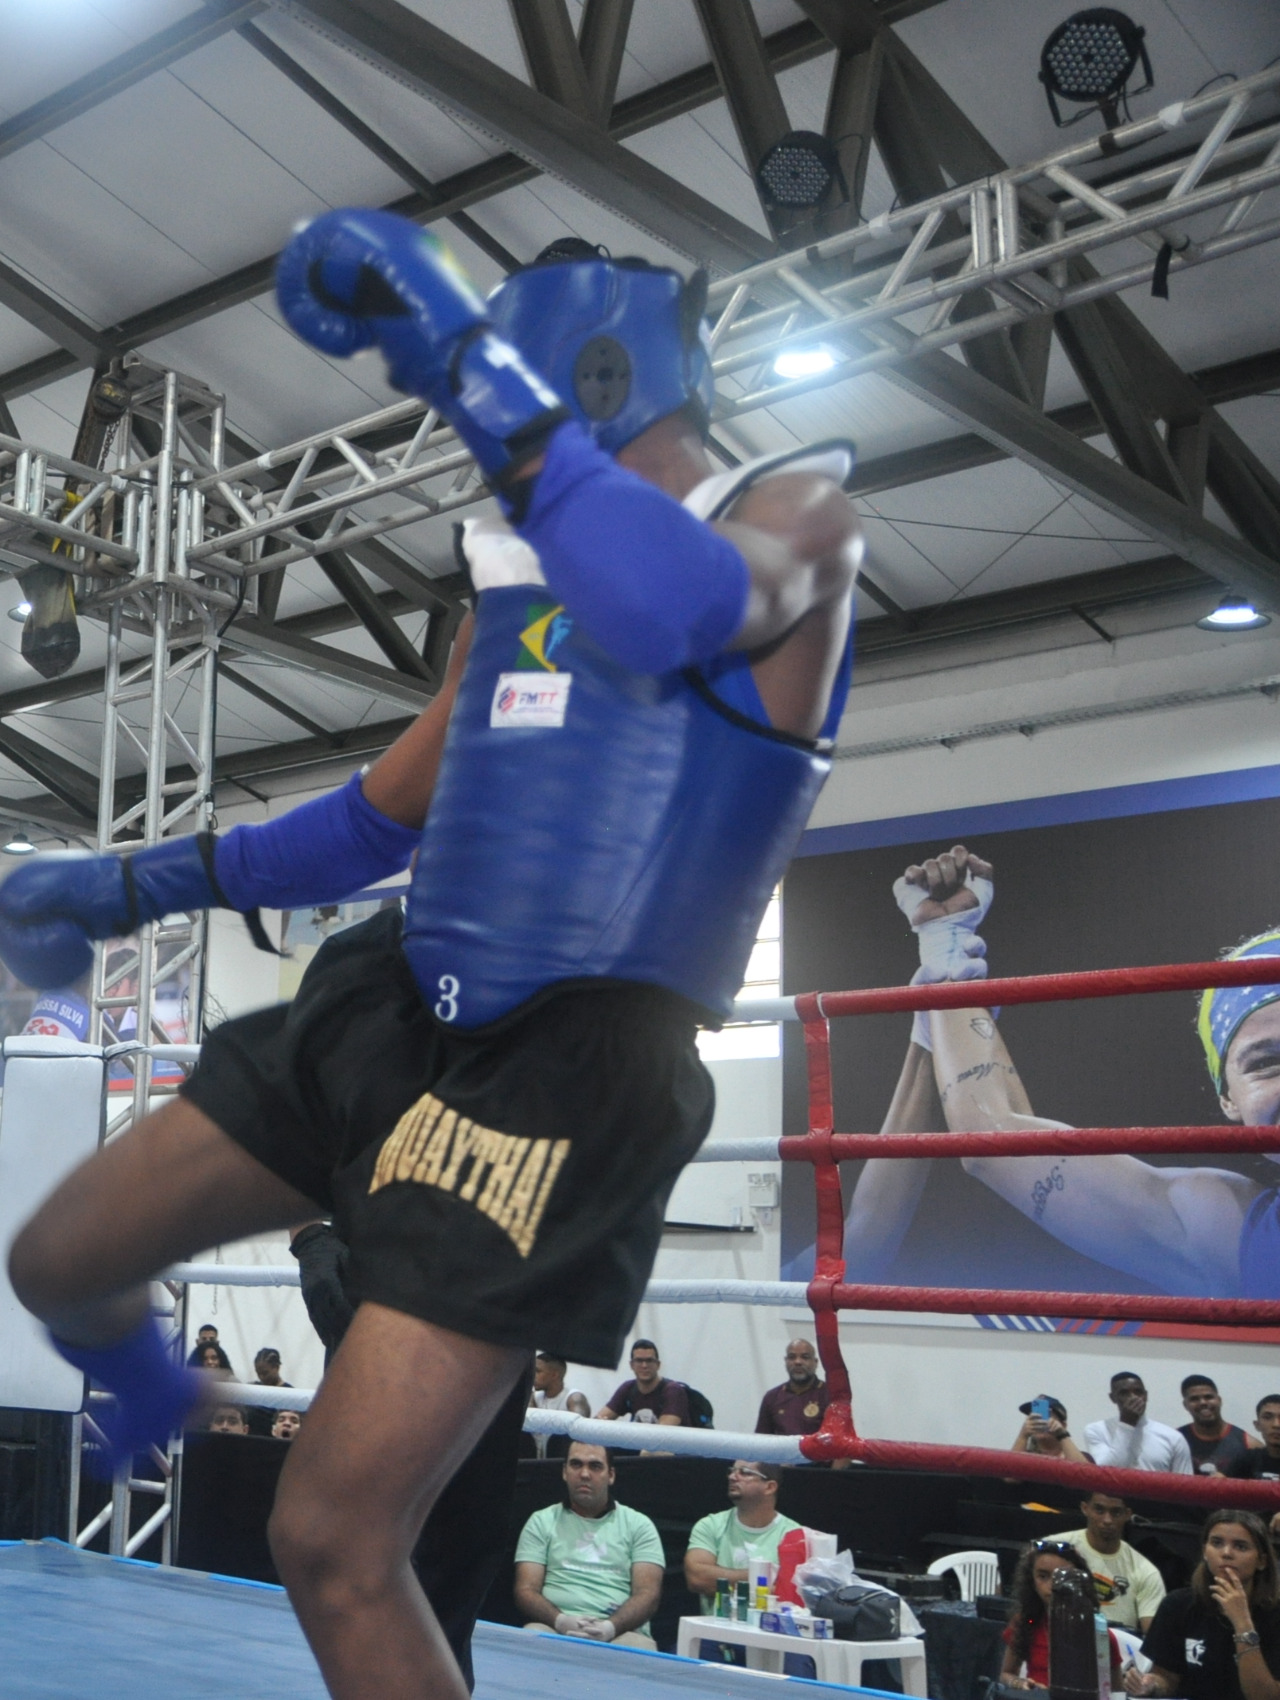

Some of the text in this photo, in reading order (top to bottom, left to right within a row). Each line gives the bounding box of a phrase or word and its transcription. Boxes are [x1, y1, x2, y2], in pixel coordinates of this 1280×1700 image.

[519, 692, 558, 704] FMTT
[434, 974, 460, 1022] 3
[58, 1004, 84, 1028] SILVA
